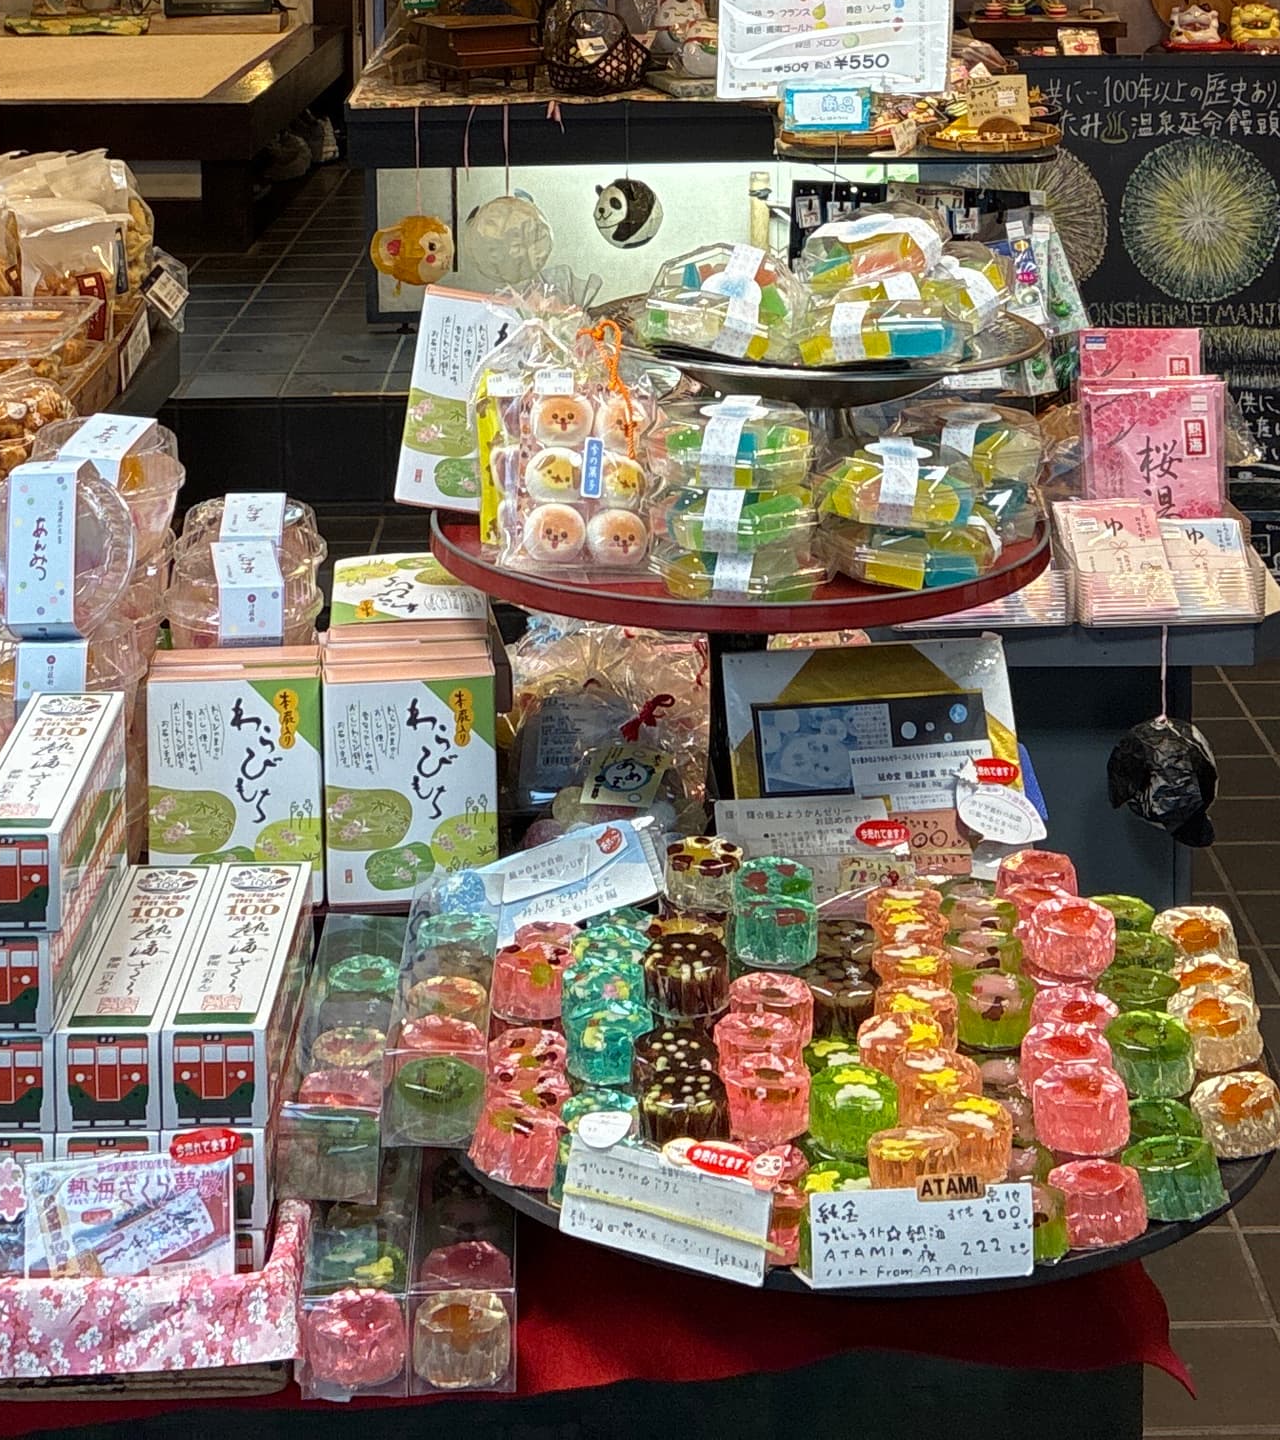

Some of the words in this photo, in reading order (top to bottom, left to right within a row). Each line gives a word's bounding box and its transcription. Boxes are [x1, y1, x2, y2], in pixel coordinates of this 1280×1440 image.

[834, 53, 890, 71] ¥550
[28, 515, 50, 582] あんみつ
[29, 726, 88, 737] 100
[229, 696, 284, 825] わらびもち
[404, 696, 460, 823] わらびもち
[127, 906, 185, 919] 100
[224, 904, 281, 917] 100
[174, 1134, 236, 1158] 今売れてます!
[920, 1175, 979, 1198] ATAMI
[981, 1205, 1022, 1223] 200
[959, 1237, 1002, 1256] 222
[876, 1264, 914, 1279] From
[919, 1262, 980, 1276] ATAMI
